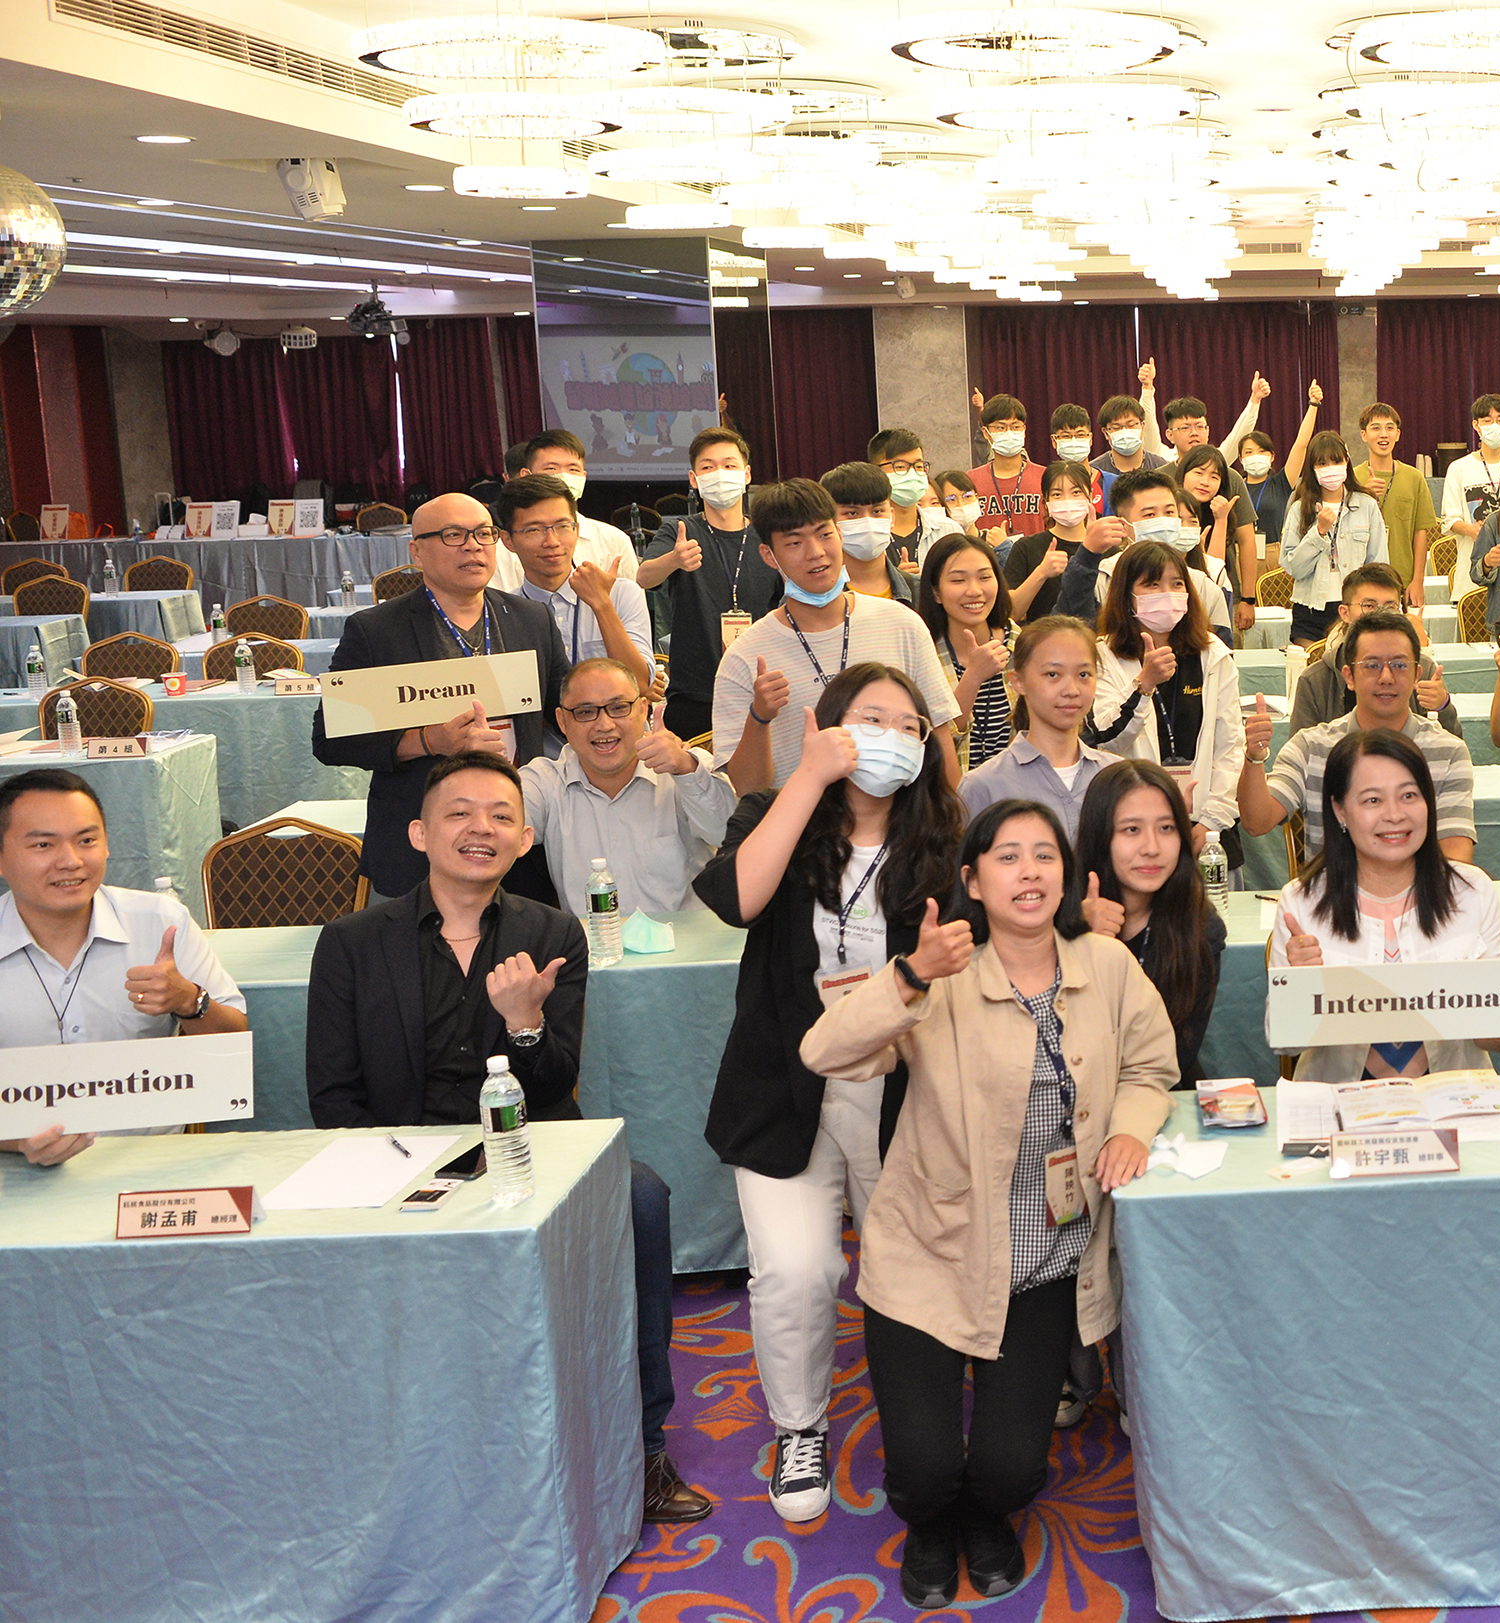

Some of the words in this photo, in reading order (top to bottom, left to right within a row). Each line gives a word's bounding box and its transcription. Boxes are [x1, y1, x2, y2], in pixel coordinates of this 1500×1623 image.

[978, 493, 1041, 517] FAITH
[284, 683, 315, 692] 第5組
[397, 682, 477, 704] Dream
[98, 744, 133, 754] 第4組
[0, 1069, 195, 1108] ooperation
[1355, 1148, 1410, 1167] 許宇甄
[140, 1209, 198, 1229] 謝孟甫
[210, 1214, 238, 1224] 總經理
